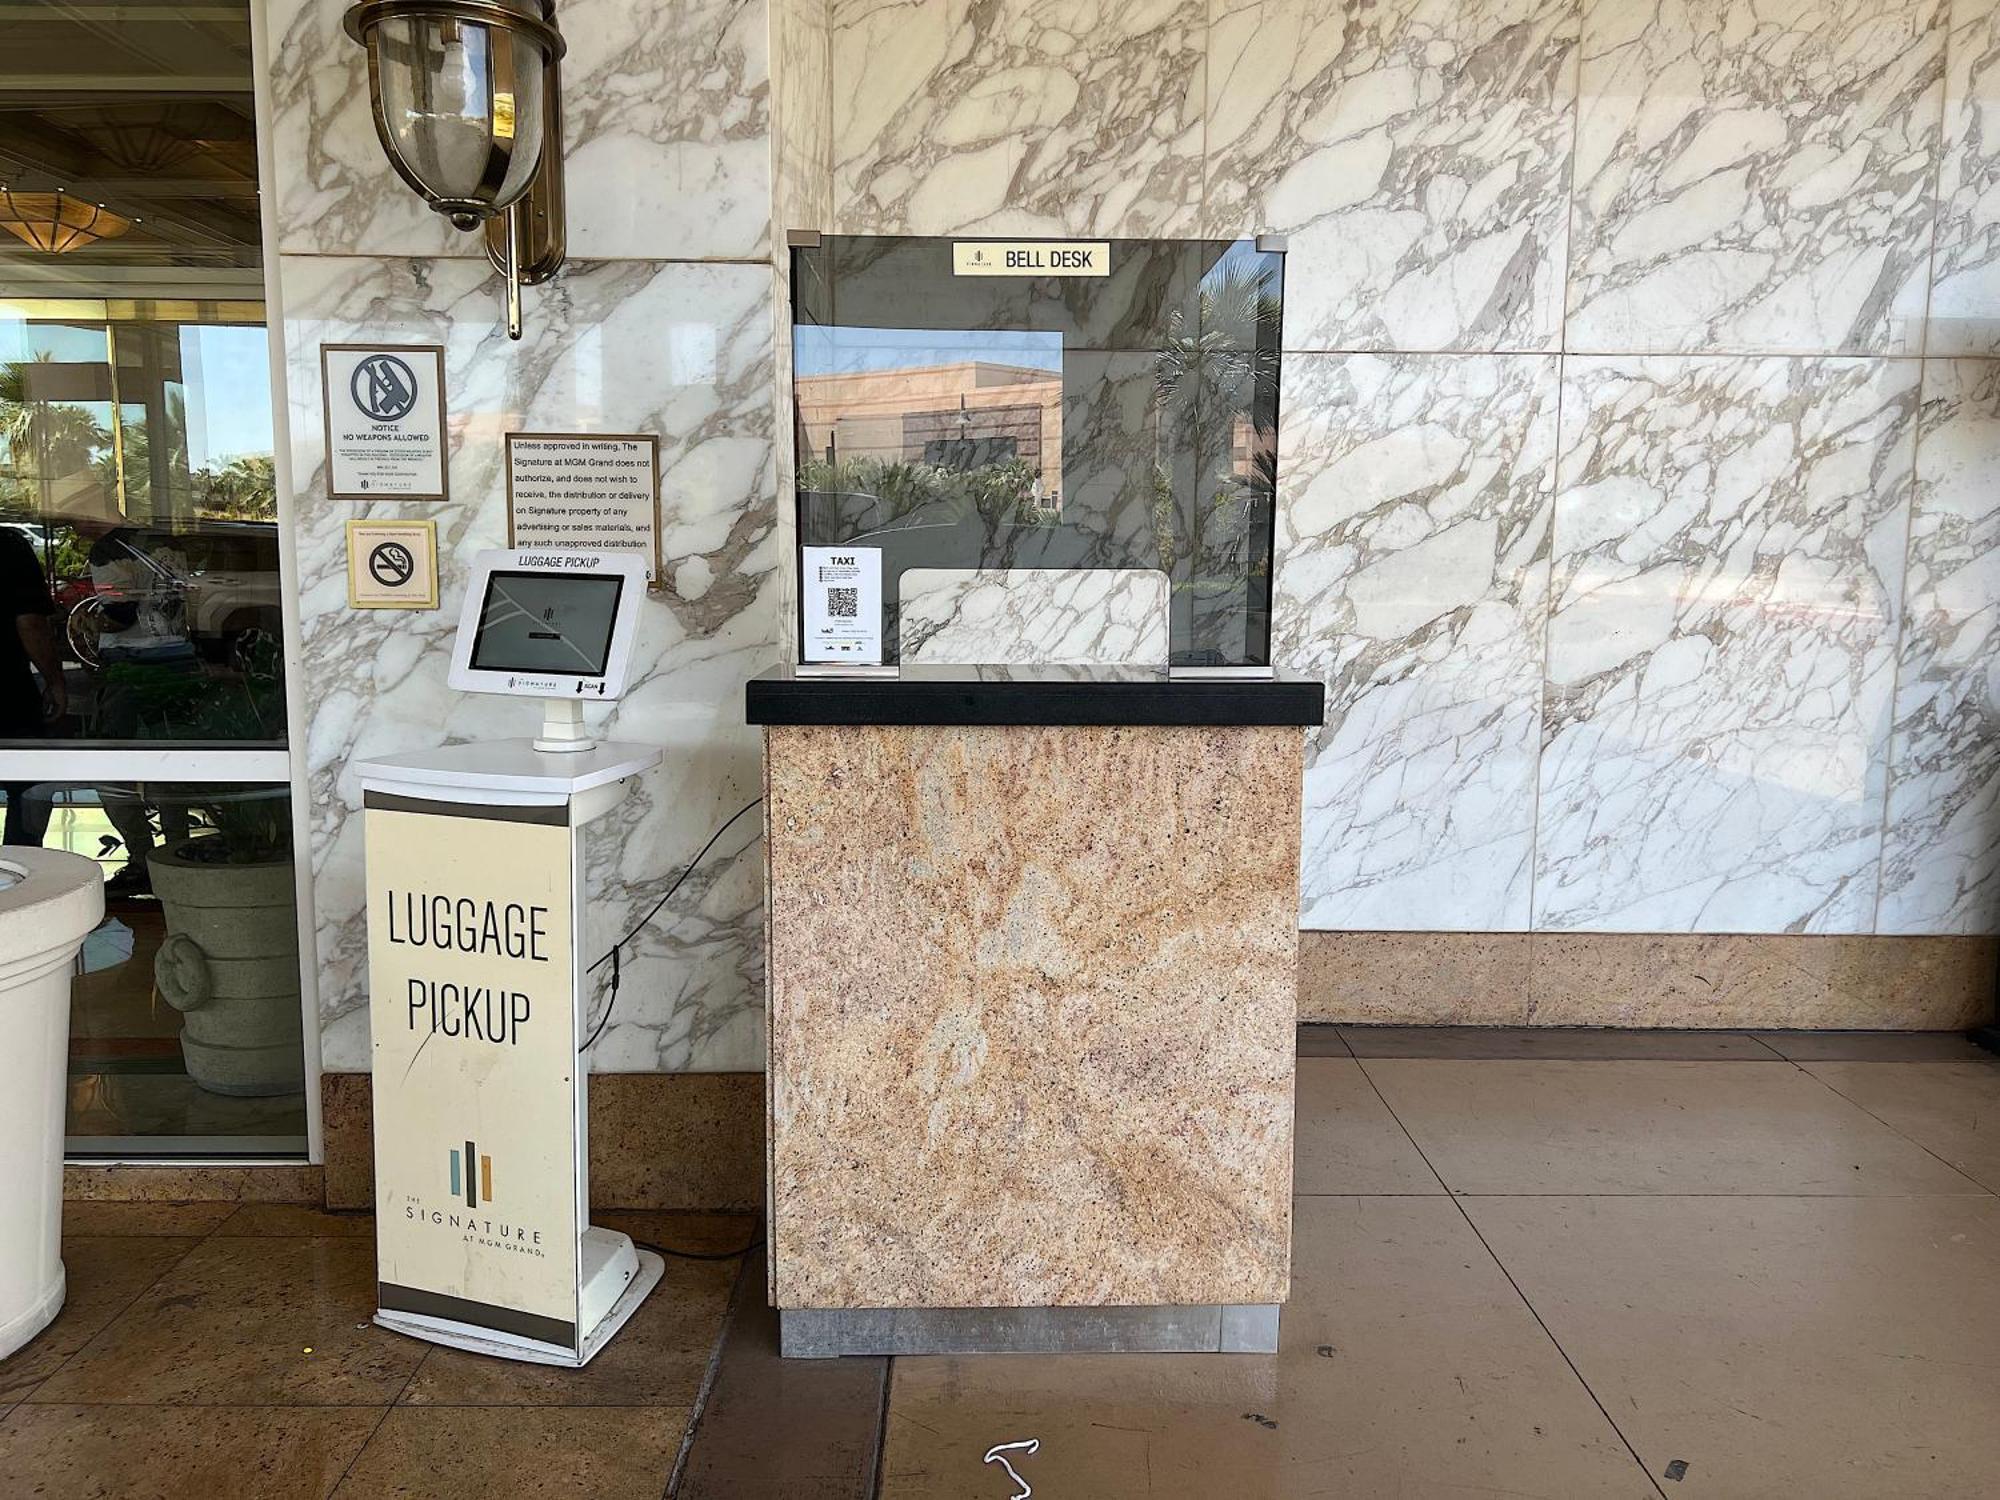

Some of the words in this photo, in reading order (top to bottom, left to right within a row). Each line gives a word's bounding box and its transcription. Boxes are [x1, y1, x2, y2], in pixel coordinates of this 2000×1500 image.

[1006, 250, 1045, 268] BELL
[1050, 250, 1092, 268] DESK
[543, 442, 580, 452] approved
[622, 443, 638, 451] The
[514, 458, 552, 467] Signature
[515, 474, 554, 483] authorize,
[564, 491, 606, 499] distribution
[618, 491, 650, 502] delivery
[528, 506, 566, 516] Signature
[568, 508, 601, 517] property
[517, 524, 560, 532] advertising
[595, 524, 634, 532] materials,
[554, 540, 602, 549] unapproved
[518, 556, 562, 567] LUGGAGE
[564, 556, 599, 568] PICKUP
[830, 557, 855, 565] TAXI
[388, 890, 548, 961] LUGGAGE
[408, 979, 530, 1045] PICKUP
[406, 1206, 541, 1244] SIGNATURE
[480, 1238, 501, 1248] MGM
